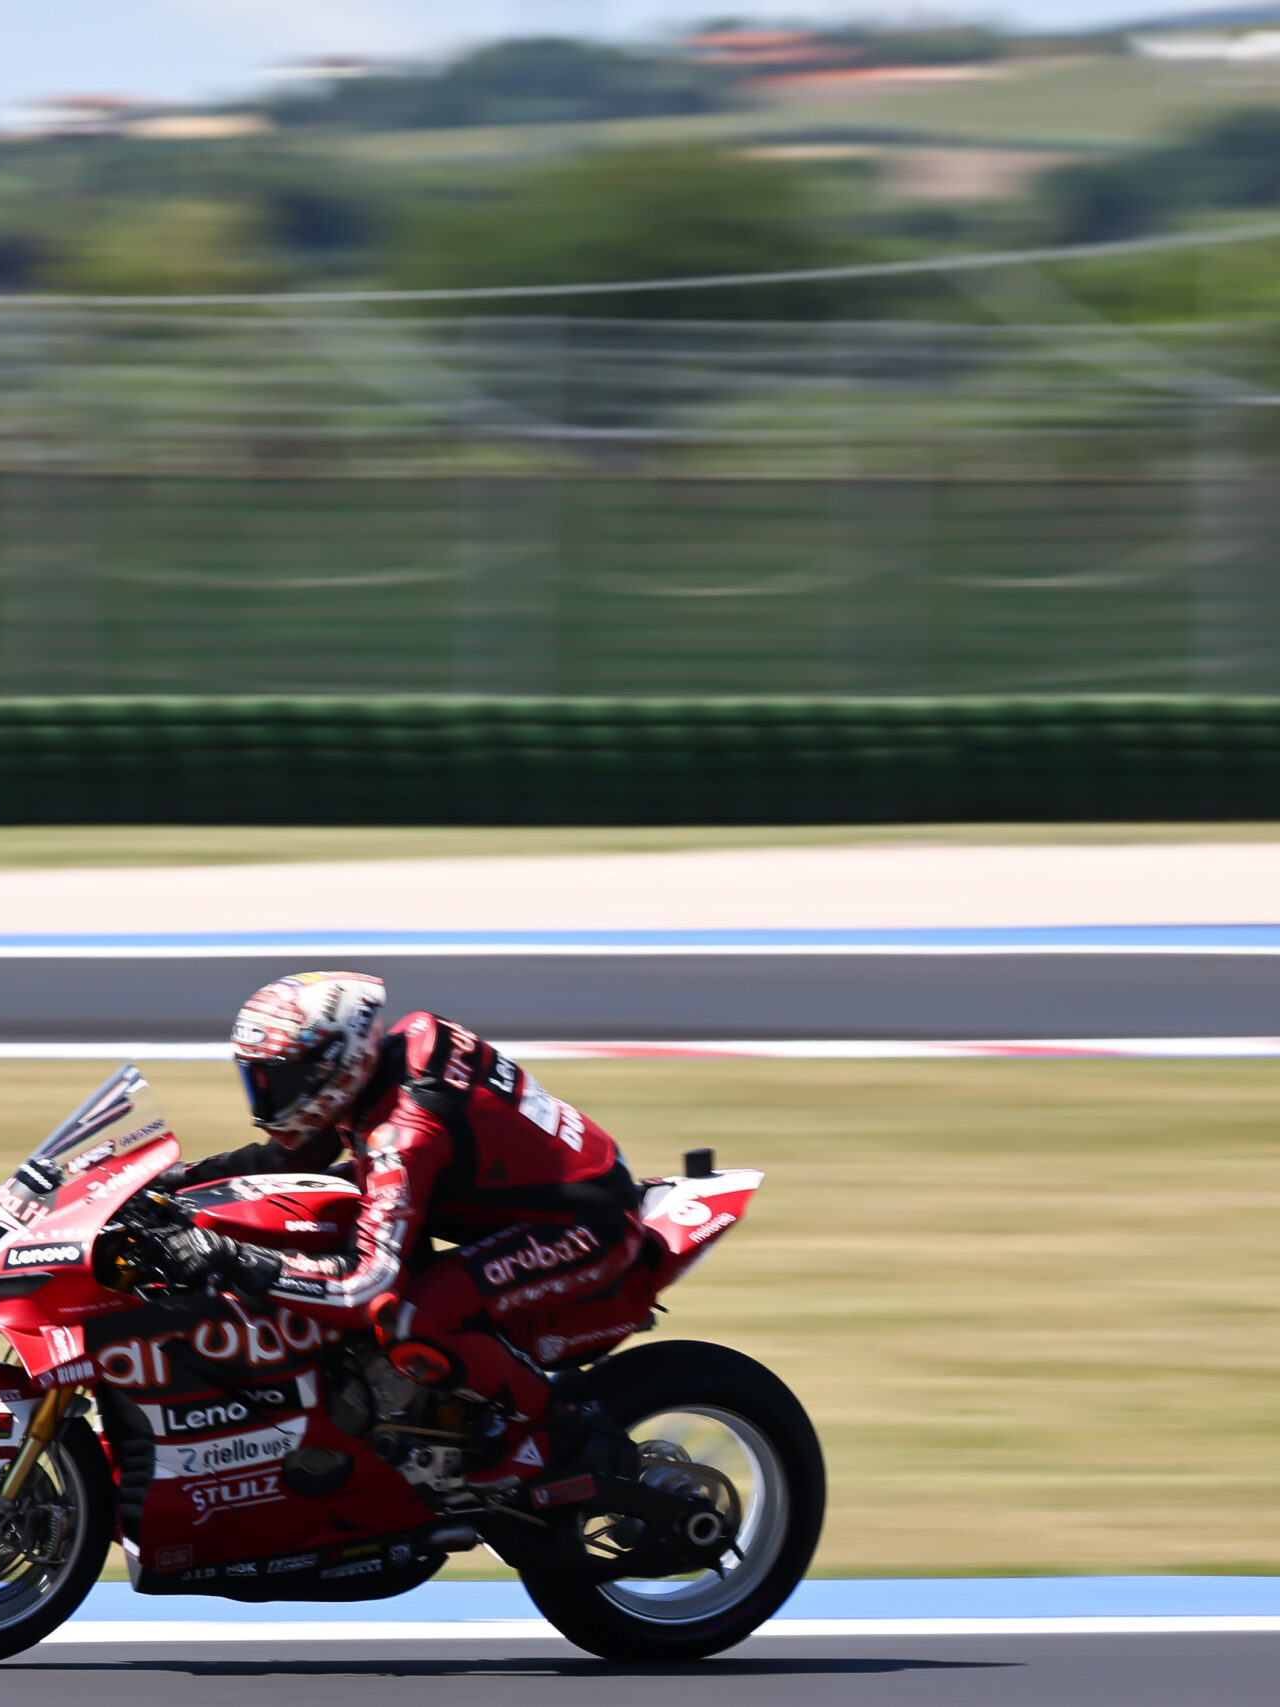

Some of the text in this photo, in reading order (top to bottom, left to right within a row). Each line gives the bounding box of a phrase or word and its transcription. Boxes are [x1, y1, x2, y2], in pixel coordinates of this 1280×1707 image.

[7, 1246, 80, 1266] Lenovo
[167, 1388, 286, 1431] Lenovo
[203, 1438, 291, 1467] riello ups
[192, 1475, 281, 1512] STULZ
